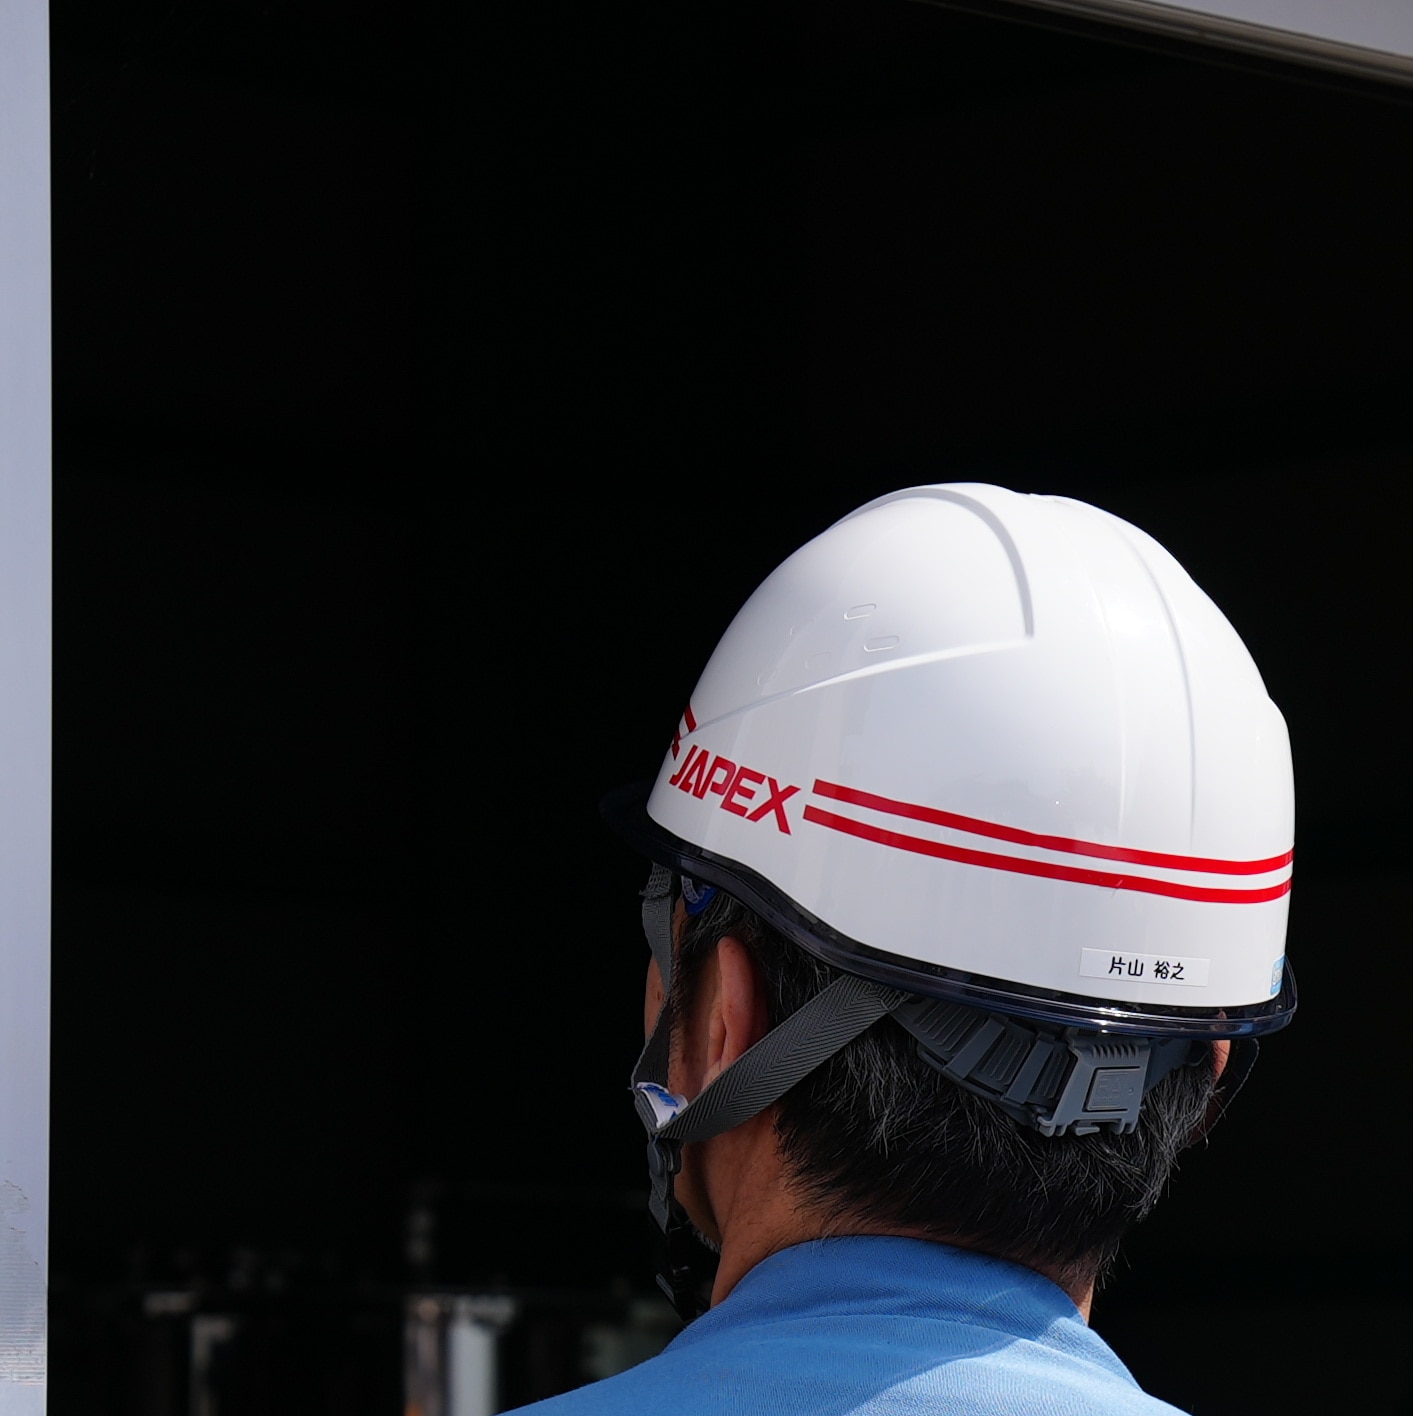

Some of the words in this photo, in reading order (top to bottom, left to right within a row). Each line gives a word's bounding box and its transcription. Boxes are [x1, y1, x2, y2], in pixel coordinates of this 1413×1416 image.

[669, 744, 802, 836] JAPEX
[1108, 956, 1144, 977] 片山
[1153, 960, 1185, 980] 裕之
